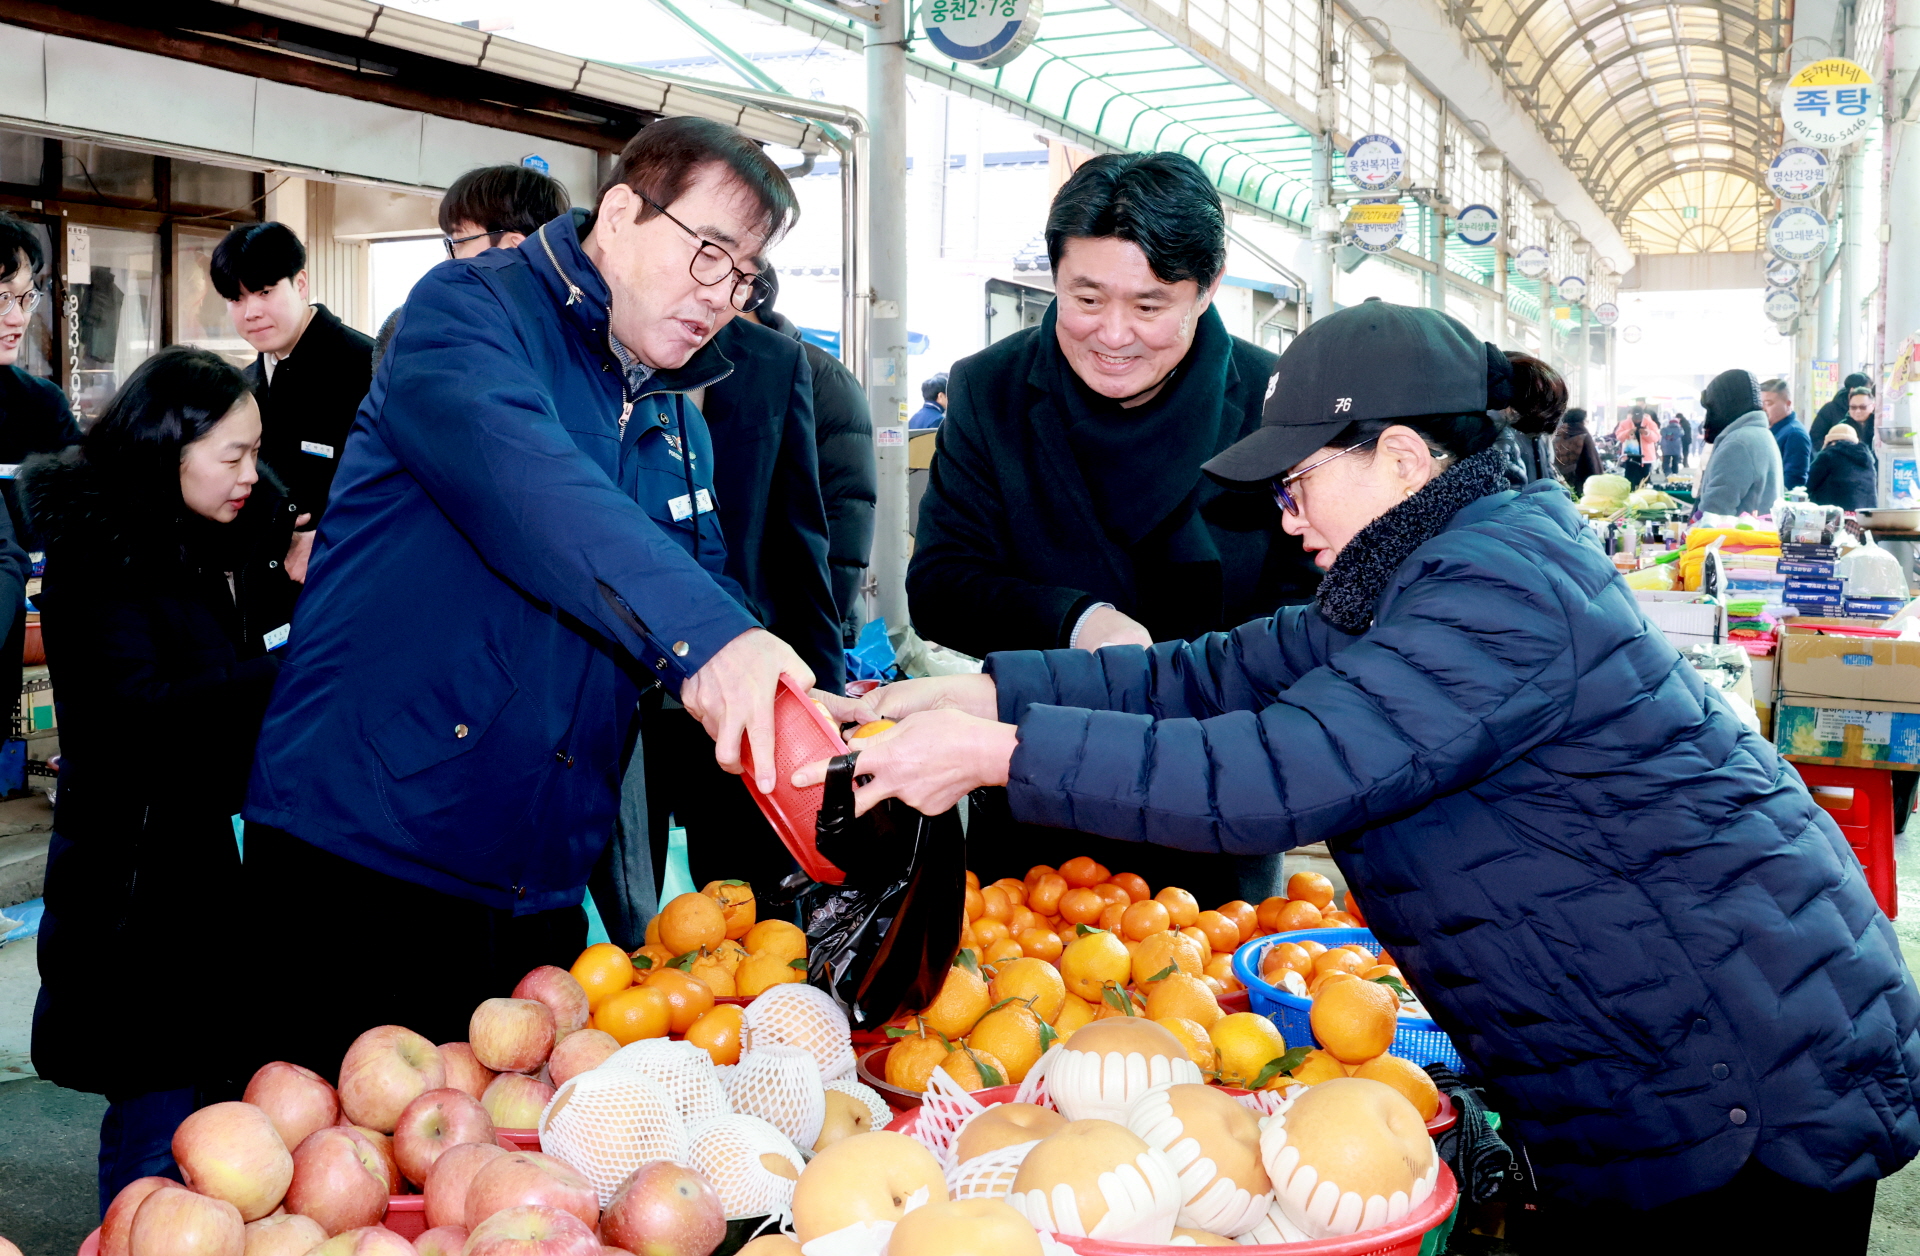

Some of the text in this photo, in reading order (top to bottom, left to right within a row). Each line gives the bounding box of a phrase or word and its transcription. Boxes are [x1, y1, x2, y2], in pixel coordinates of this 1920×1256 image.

[1801, 63, 1861, 83] 두꺼비네
[1793, 87, 1871, 117] 족탕
[1793, 117, 1866, 143] 041-936-5446
[1350, 157, 1400, 172] 웅천복지관
[1773, 168, 1824, 183] 명산건강원
[1457, 221, 1498, 232] 온누리상품권
[1774, 228, 1825, 243] 빙그레분식
[1334, 397, 1352, 414] 76
